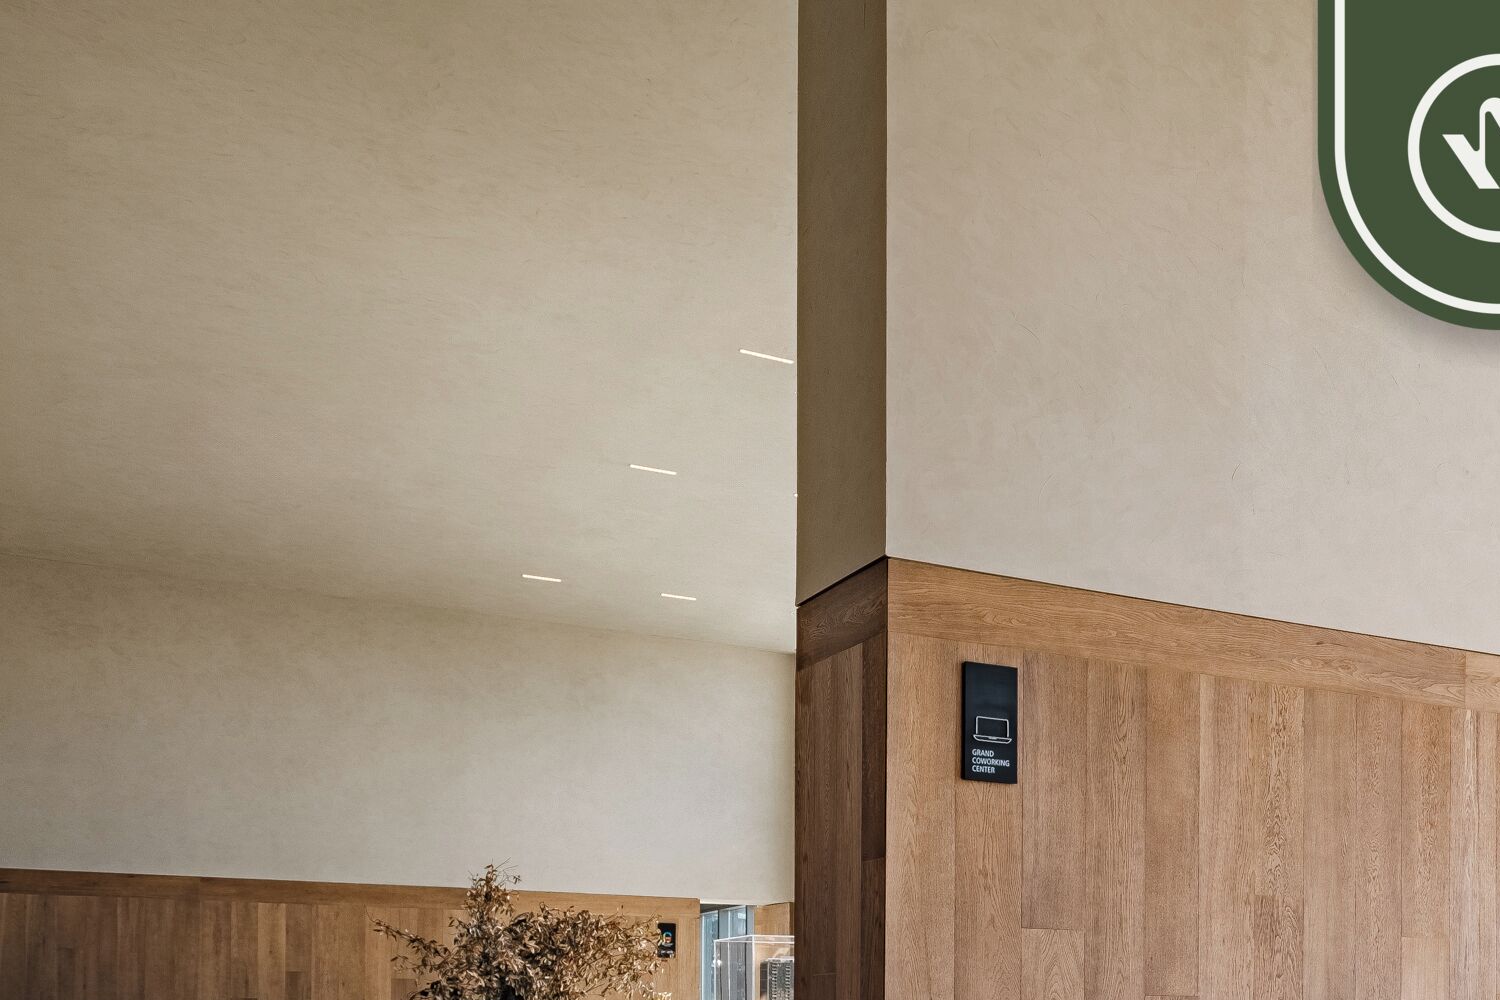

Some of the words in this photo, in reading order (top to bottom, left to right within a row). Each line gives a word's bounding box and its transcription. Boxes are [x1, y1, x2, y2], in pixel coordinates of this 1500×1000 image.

[972, 749, 994, 757] GRAND
[972, 757, 1010, 767] COWORKING
[972, 765, 995, 773] CENTER
